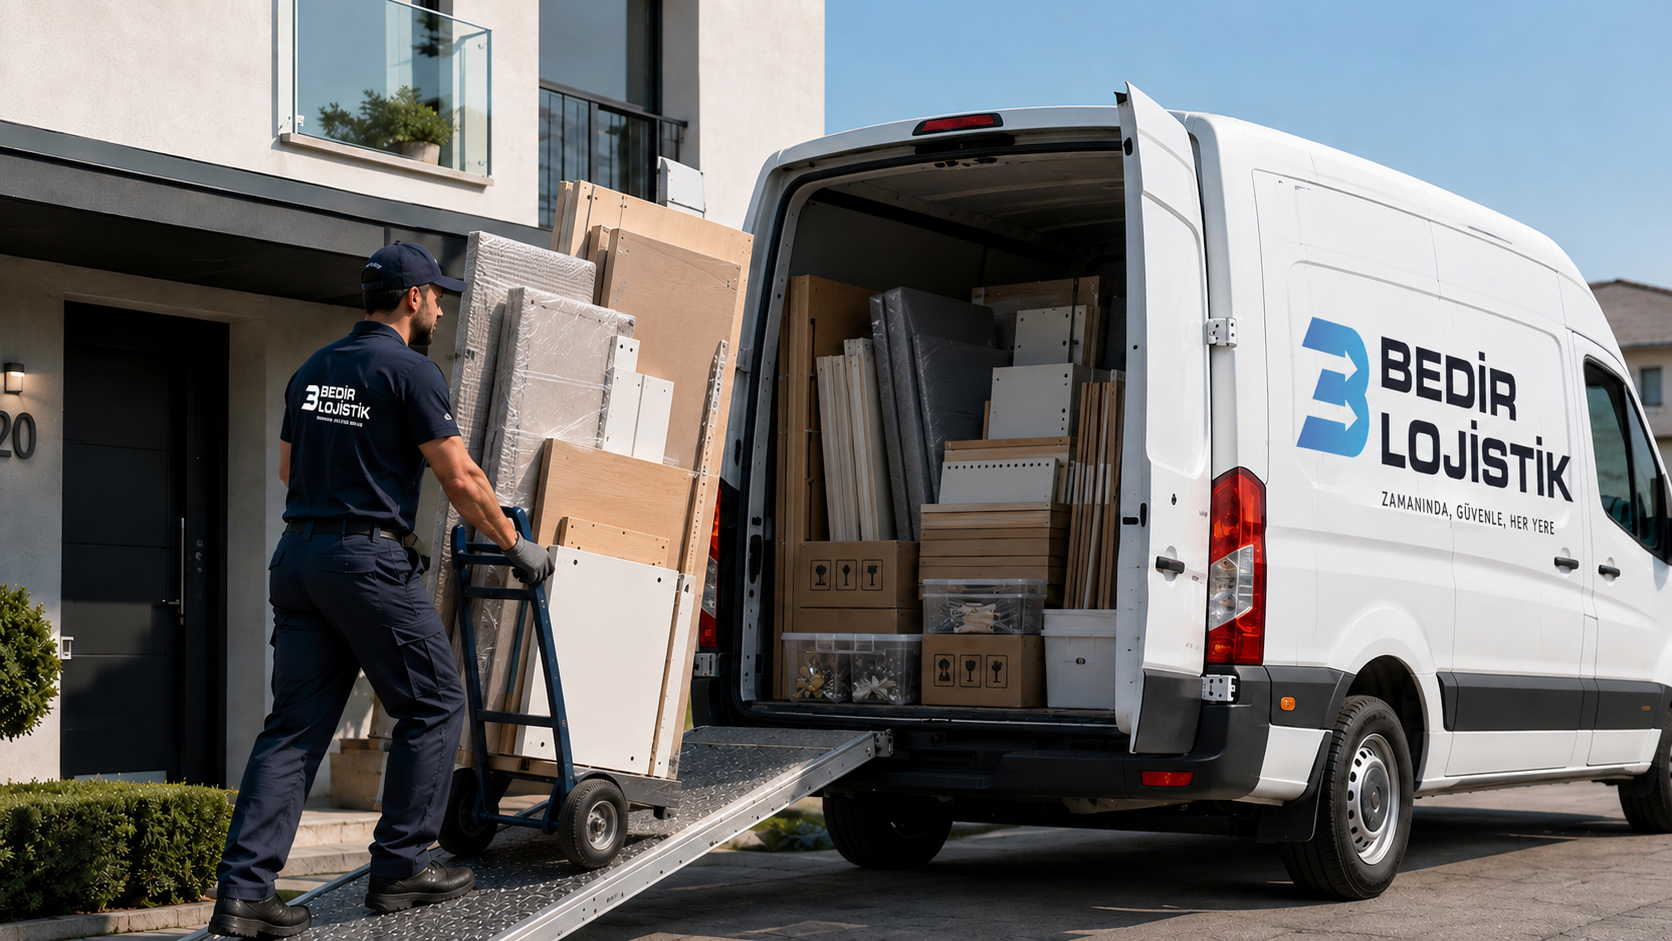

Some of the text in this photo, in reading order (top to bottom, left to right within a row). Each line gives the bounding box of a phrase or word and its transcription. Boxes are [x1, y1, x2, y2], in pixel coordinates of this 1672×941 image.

[320, 385, 356, 401] BEDİR
[1380, 336, 1517, 422] BEDİR
[318, 400, 371, 420] LOJİSTİK
[1380, 411, 1574, 503] LOJİSTİK
[1381, 491, 1555, 536] ZAMANINDA, GÜVENLE, HER YERE
